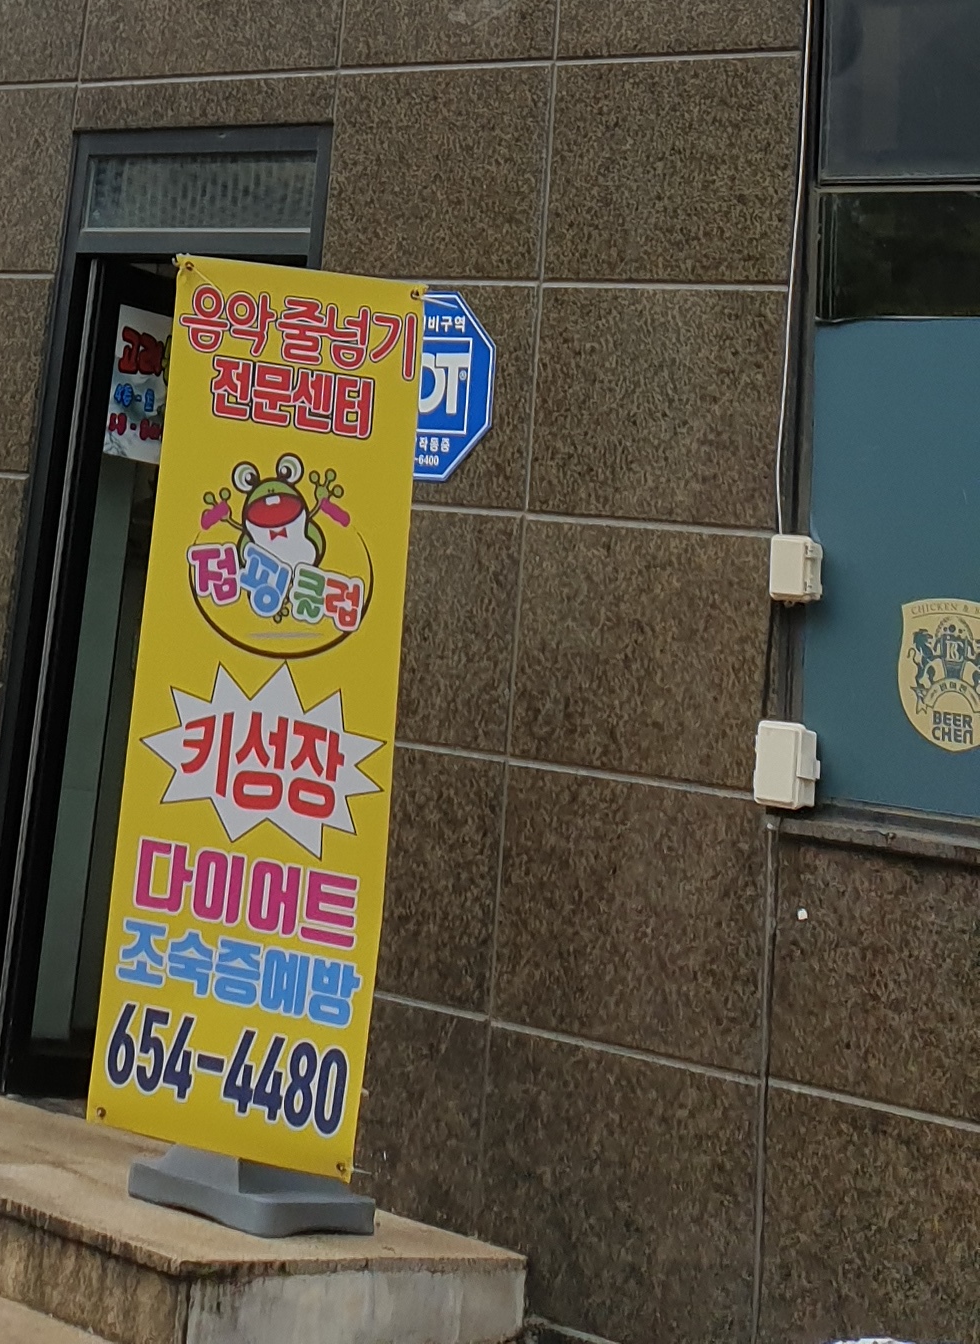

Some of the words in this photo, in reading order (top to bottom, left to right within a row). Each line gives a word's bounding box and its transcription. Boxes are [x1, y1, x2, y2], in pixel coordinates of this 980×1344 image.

[210, 355, 375, 440] 전문센터
[186, 541, 366, 632] 점핑클럽
[911, 601, 959, 616] CHICKEN
[179, 709, 346, 819] 키성장
[932, 710, 974, 730] BEER
[132, 837, 361, 950] 다이어트
[116, 917, 363, 1029] 조숙증예방
[104, 1001, 351, 1138] 654-4480
